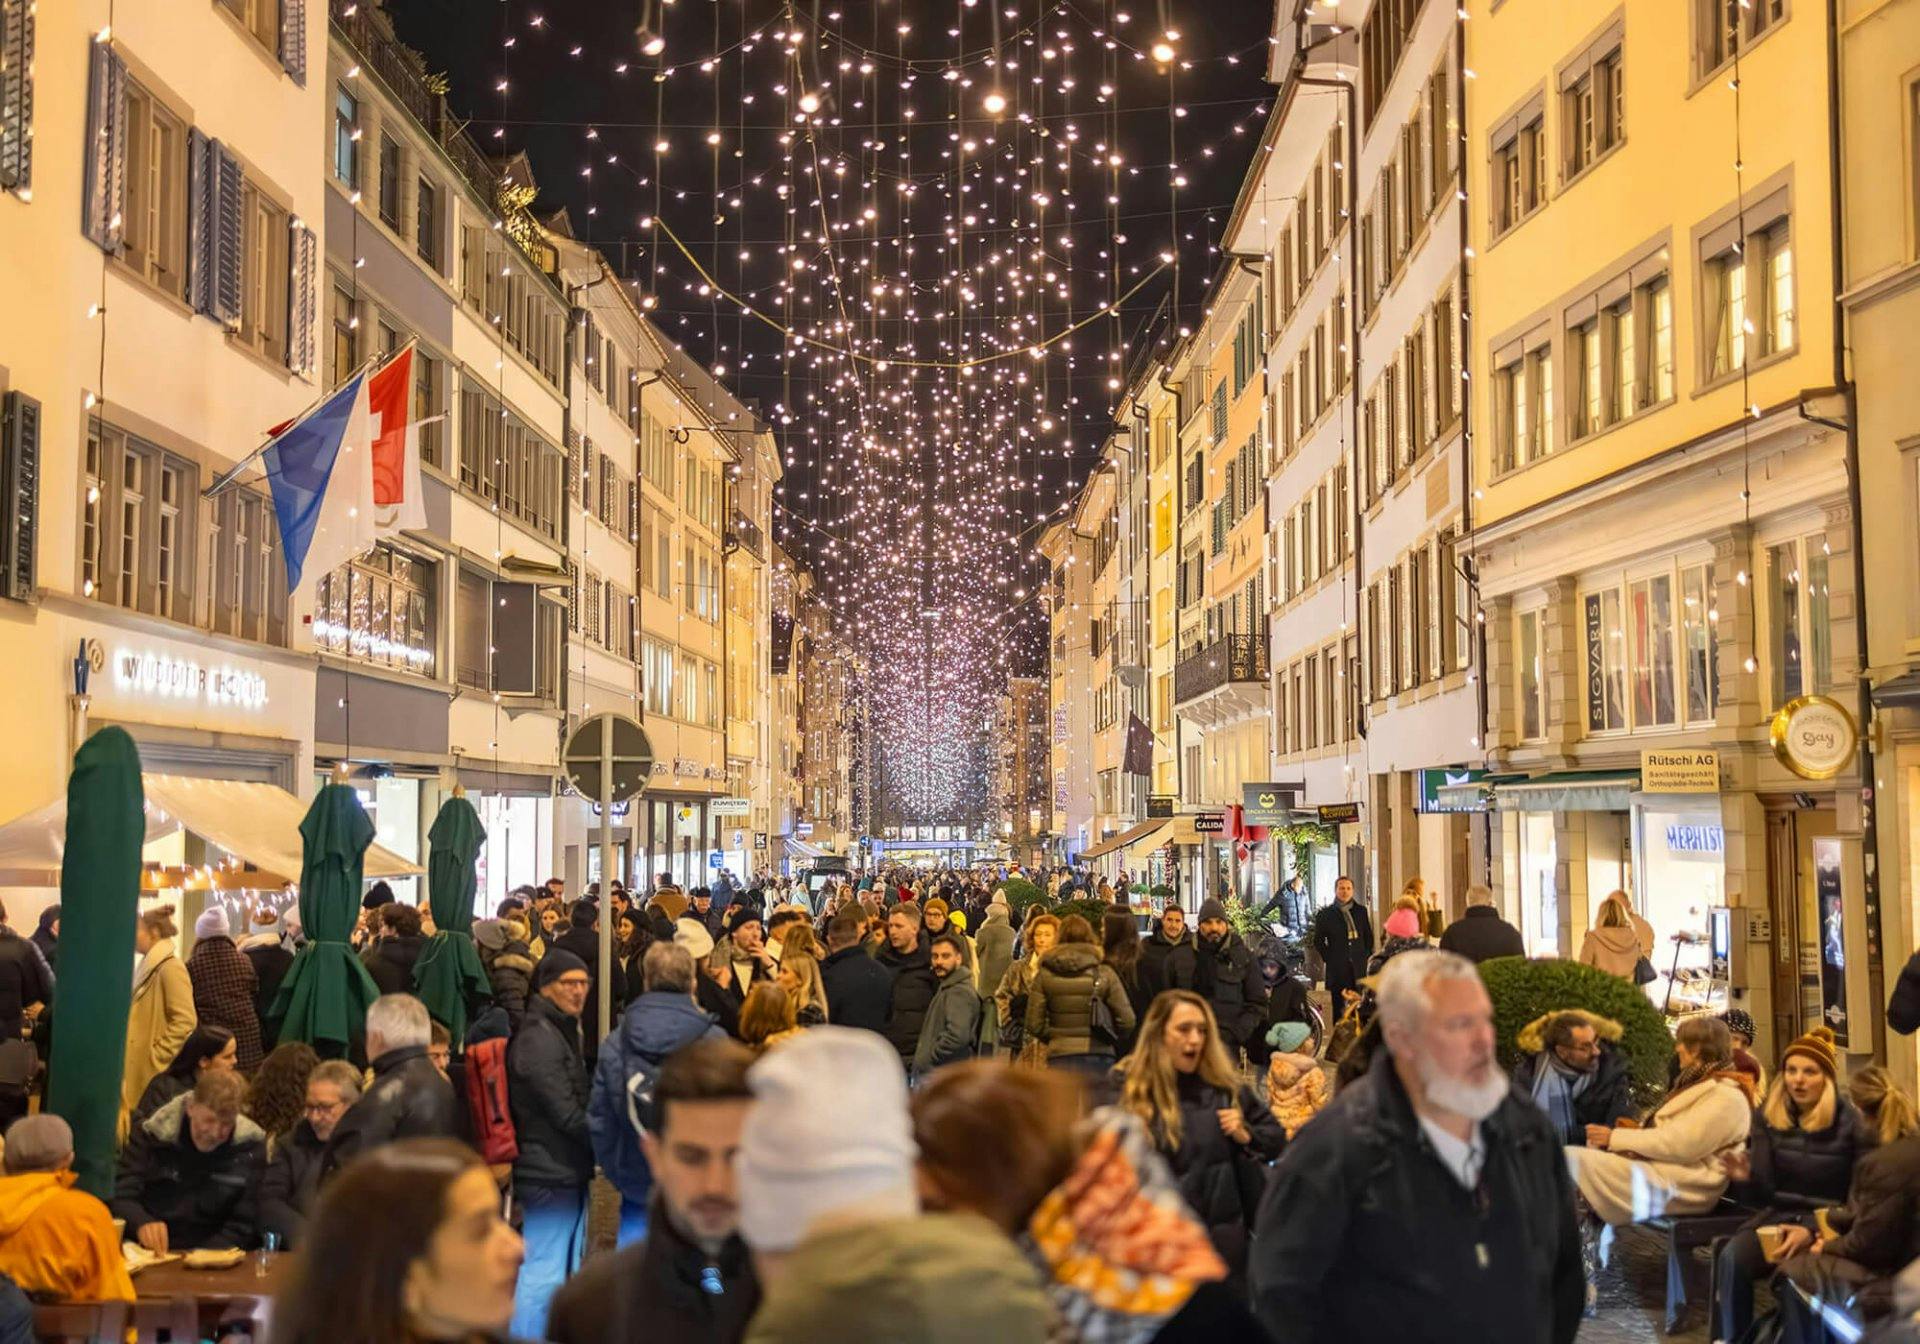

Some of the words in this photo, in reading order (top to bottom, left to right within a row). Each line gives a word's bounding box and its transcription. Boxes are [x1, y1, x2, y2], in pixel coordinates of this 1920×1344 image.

[1589, 603, 1603, 721] SIGVARIS
[1648, 754, 1693, 766] Rütschi
[1696, 754, 1714, 765] AG
[1196, 821, 1224, 829] CALIDA
